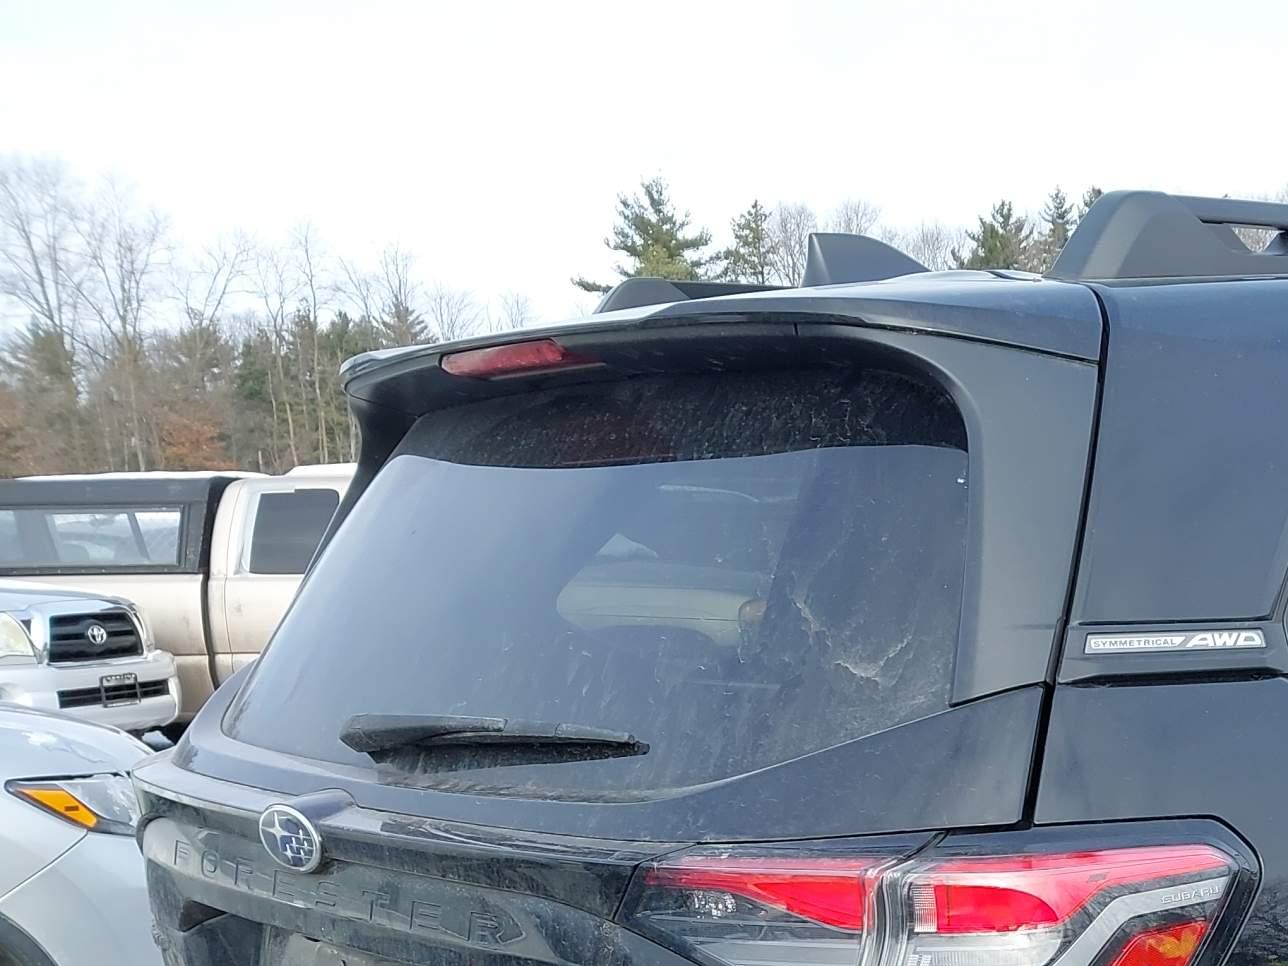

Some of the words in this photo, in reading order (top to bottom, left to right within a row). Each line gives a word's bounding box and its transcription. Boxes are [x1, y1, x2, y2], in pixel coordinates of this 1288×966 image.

[1093, 638, 1178, 648] SYMMETRICAL
[1186, 631, 1263, 648] AWD
[173, 841, 526, 945] FORESTER
[1161, 887, 1218, 903] SUBARU
